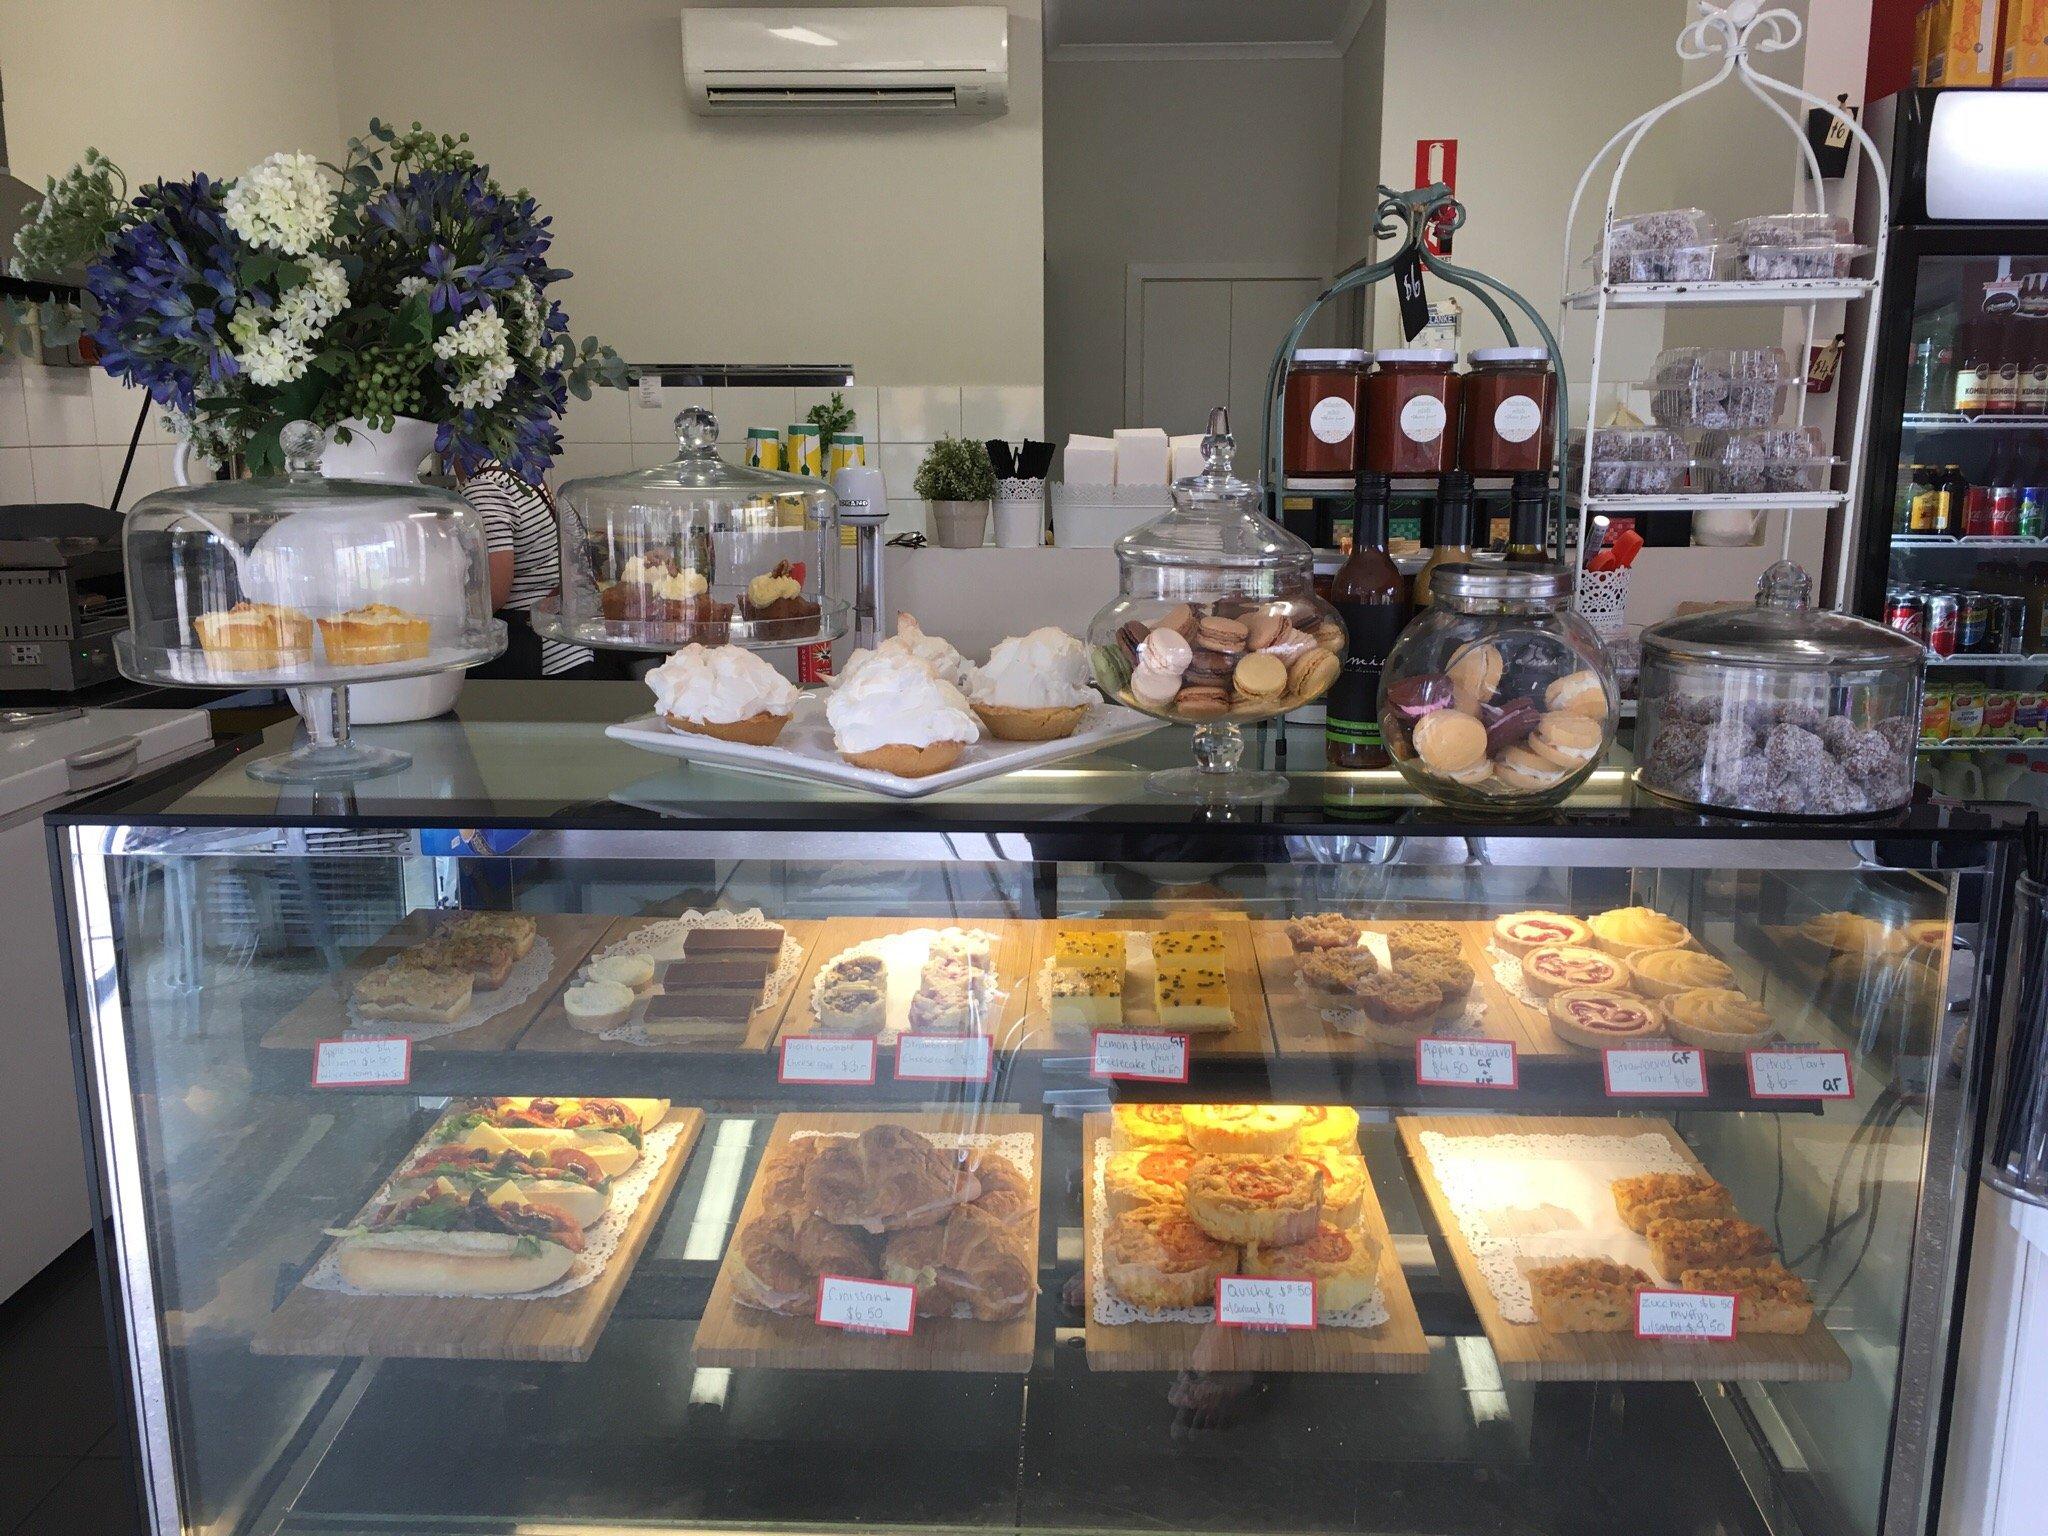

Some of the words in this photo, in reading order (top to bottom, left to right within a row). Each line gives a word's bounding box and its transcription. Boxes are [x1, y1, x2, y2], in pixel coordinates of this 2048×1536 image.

[1098, 1037, 1129, 1050] Lemon
[1424, 1043, 1454, 1058] Apple
[1672, 1051, 1691, 1065] GF
[1795, 1055, 1826, 1070] Tart
[828, 1286, 892, 1302] Croissant
